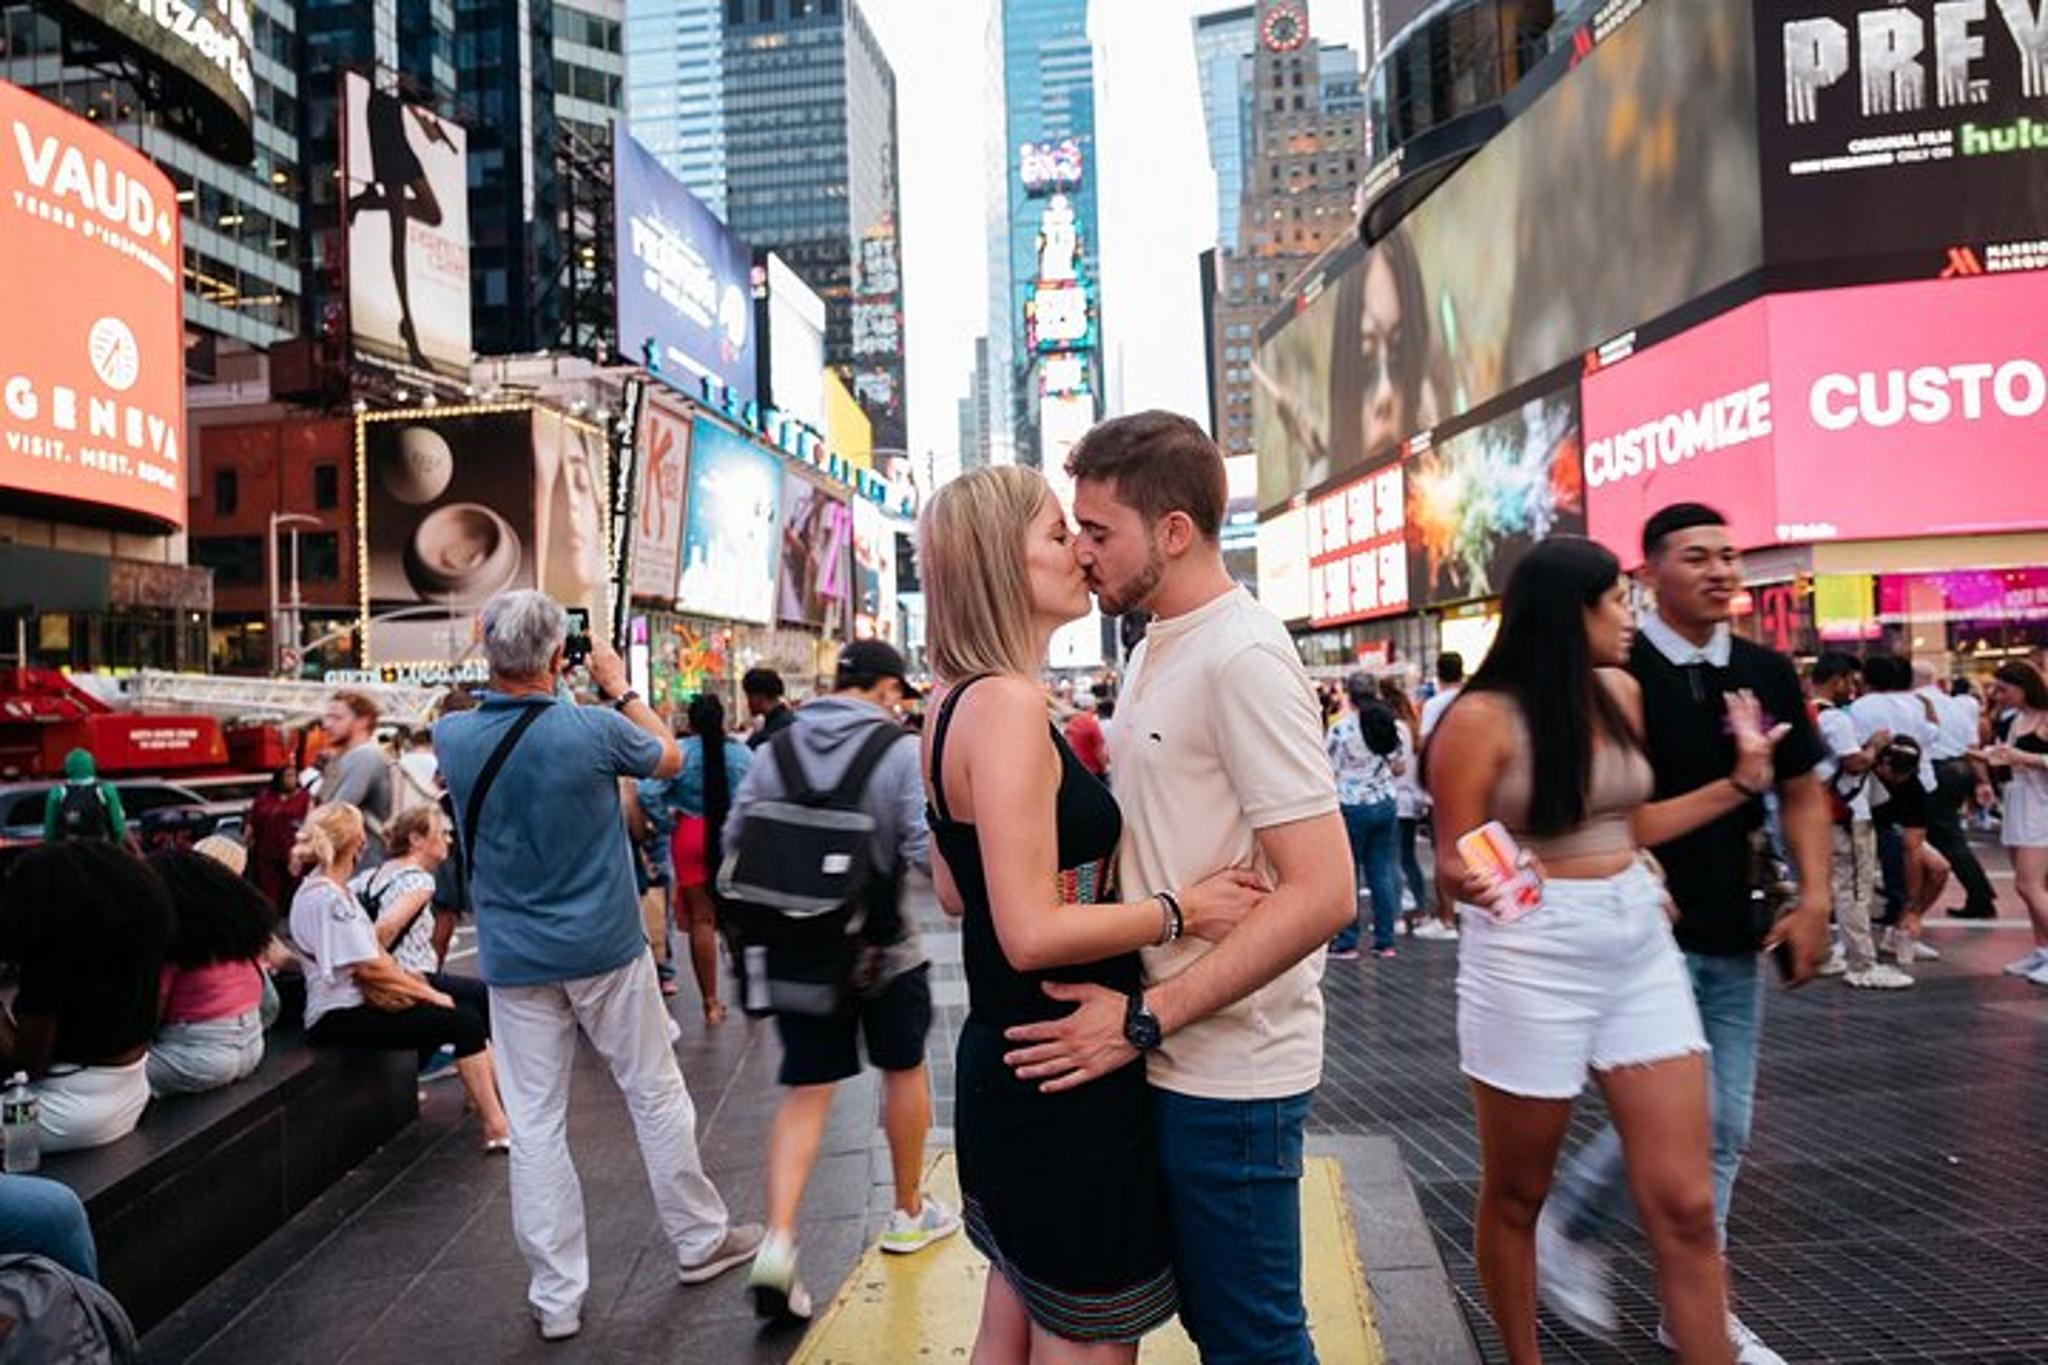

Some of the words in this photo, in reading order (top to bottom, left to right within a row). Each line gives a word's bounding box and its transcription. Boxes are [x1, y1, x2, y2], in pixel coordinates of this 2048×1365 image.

[5, 374, 177, 463] GENEVA
[1810, 360, 2047, 430] CUSTO
[6, 431, 72, 463] VISIT.
[1584, 382, 1772, 488] CUSTOMIZE
